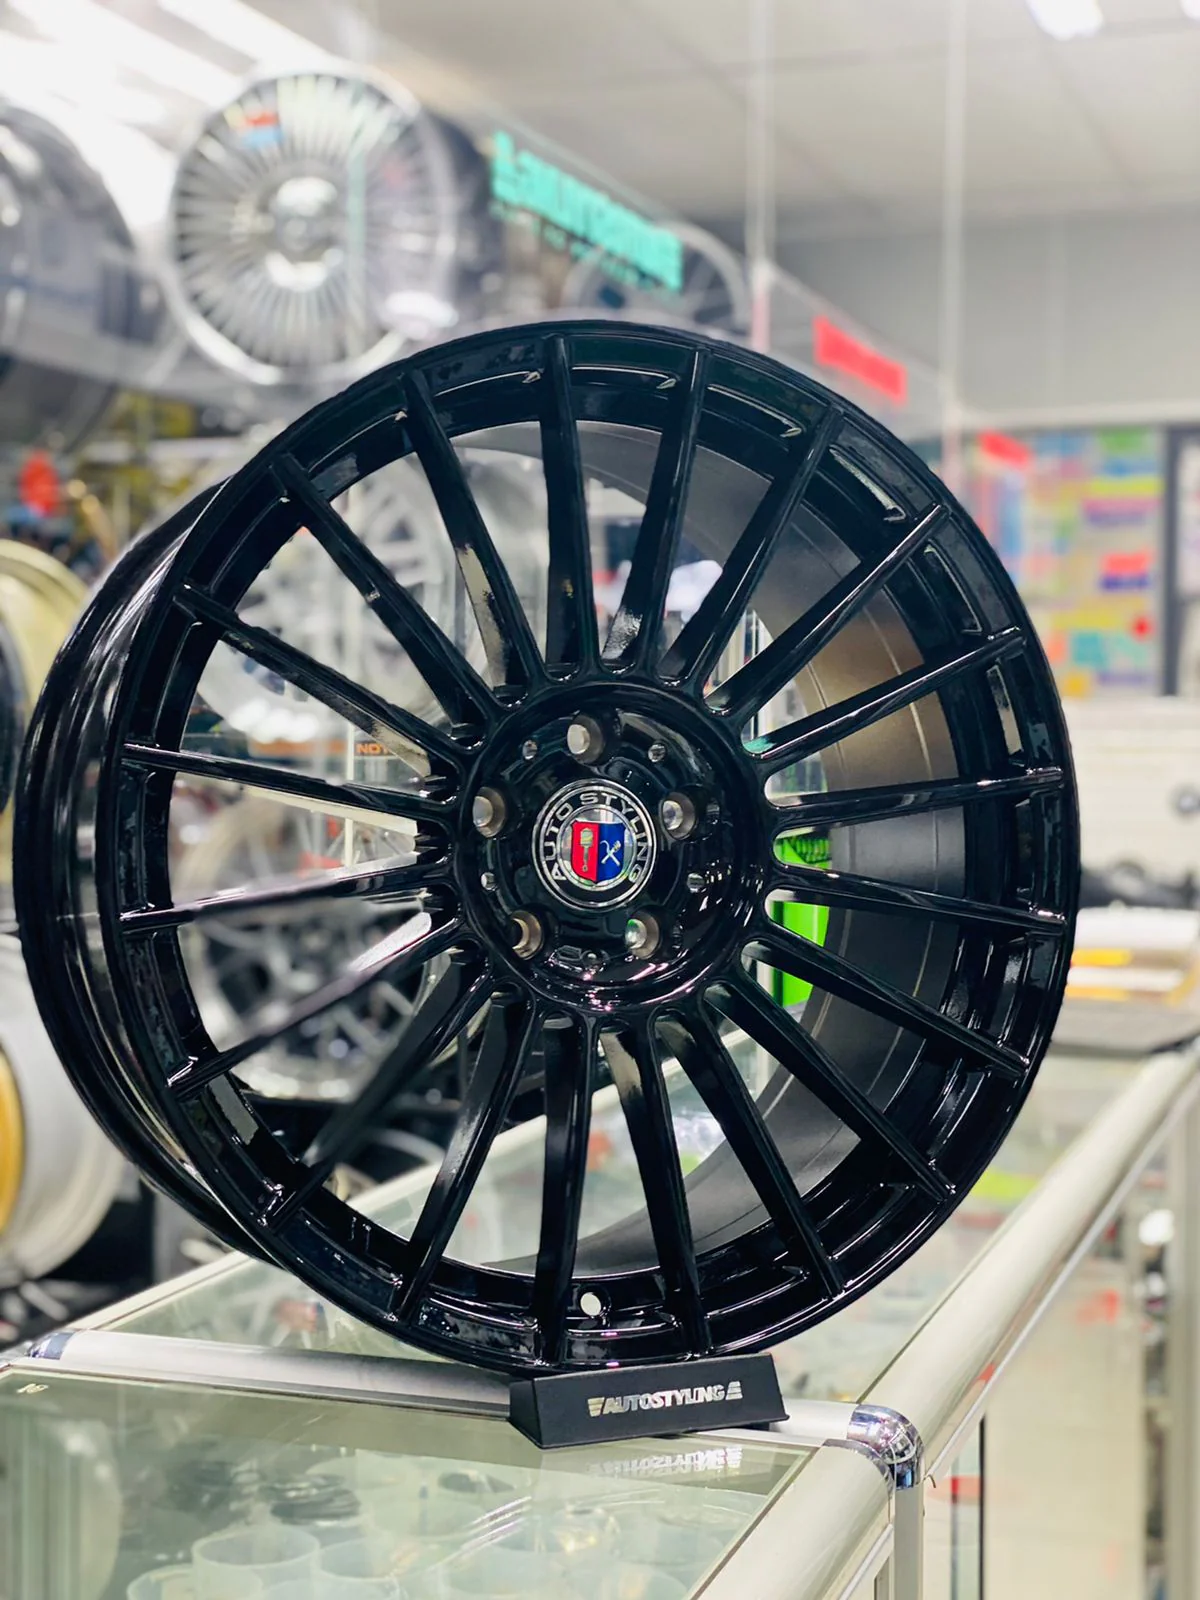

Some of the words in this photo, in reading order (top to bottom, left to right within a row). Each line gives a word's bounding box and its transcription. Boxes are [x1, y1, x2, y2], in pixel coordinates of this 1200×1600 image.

[544, 803, 574, 881] AUTO
[579, 792, 649, 883] STYLING
[603, 1385, 725, 1414] AUTOSTYLING
